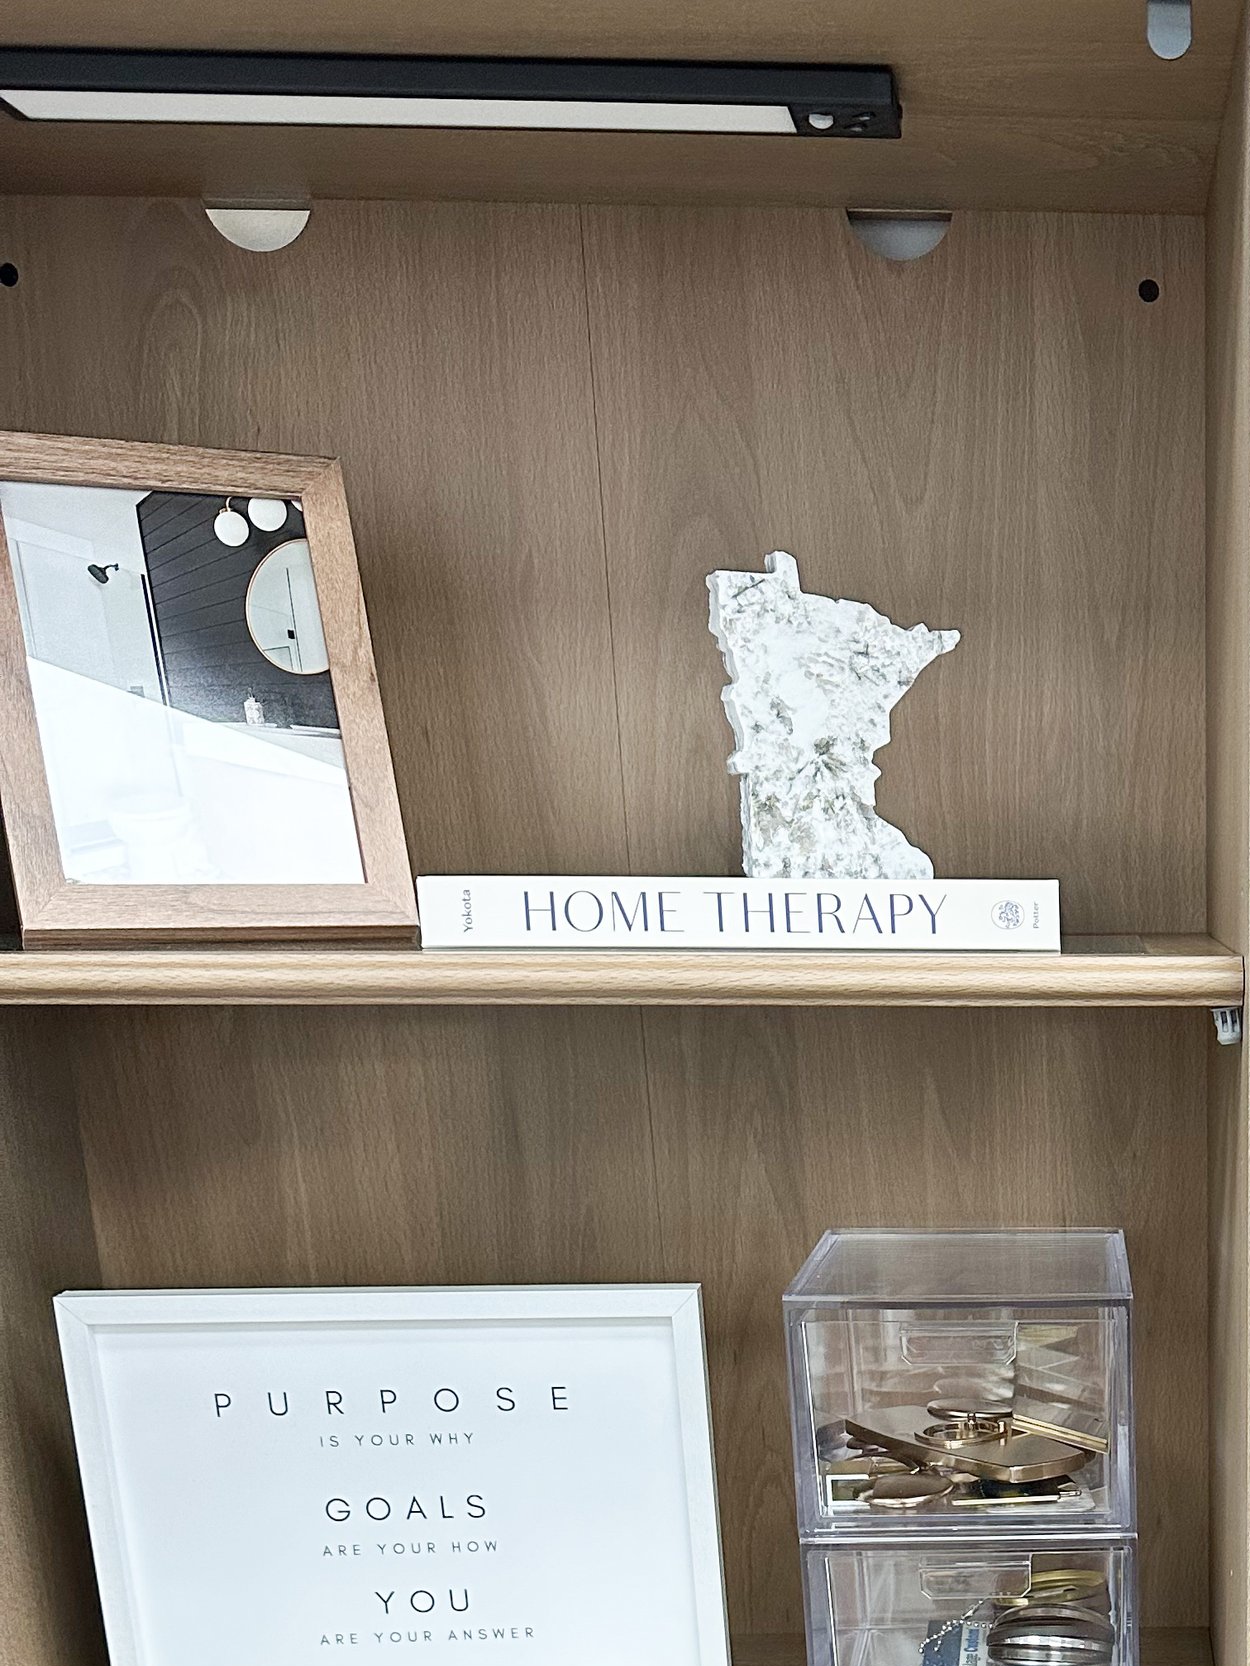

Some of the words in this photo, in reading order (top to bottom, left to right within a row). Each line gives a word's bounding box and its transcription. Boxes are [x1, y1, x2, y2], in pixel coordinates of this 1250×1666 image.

[460, 889, 474, 934] Yokota
[523, 889, 686, 933] HOME
[702, 891, 948, 935] THERAPY
[213, 1386, 569, 1418] PURPOSE
[319, 1435, 340, 1448] IS
[353, 1433, 415, 1447] YOUR
[428, 1432, 475, 1446] WHY
[324, 1494, 487, 1523] GOALS
[322, 1543, 362, 1557] ARE
[375, 1542, 437, 1556] YOUR
[451, 1540, 499, 1553] HOW
[373, 1587, 470, 1615] YOU
[319, 1632, 359, 1646] ARE
[374, 1630, 433, 1644] YOUR
[448, 1626, 535, 1641] ANSWER
